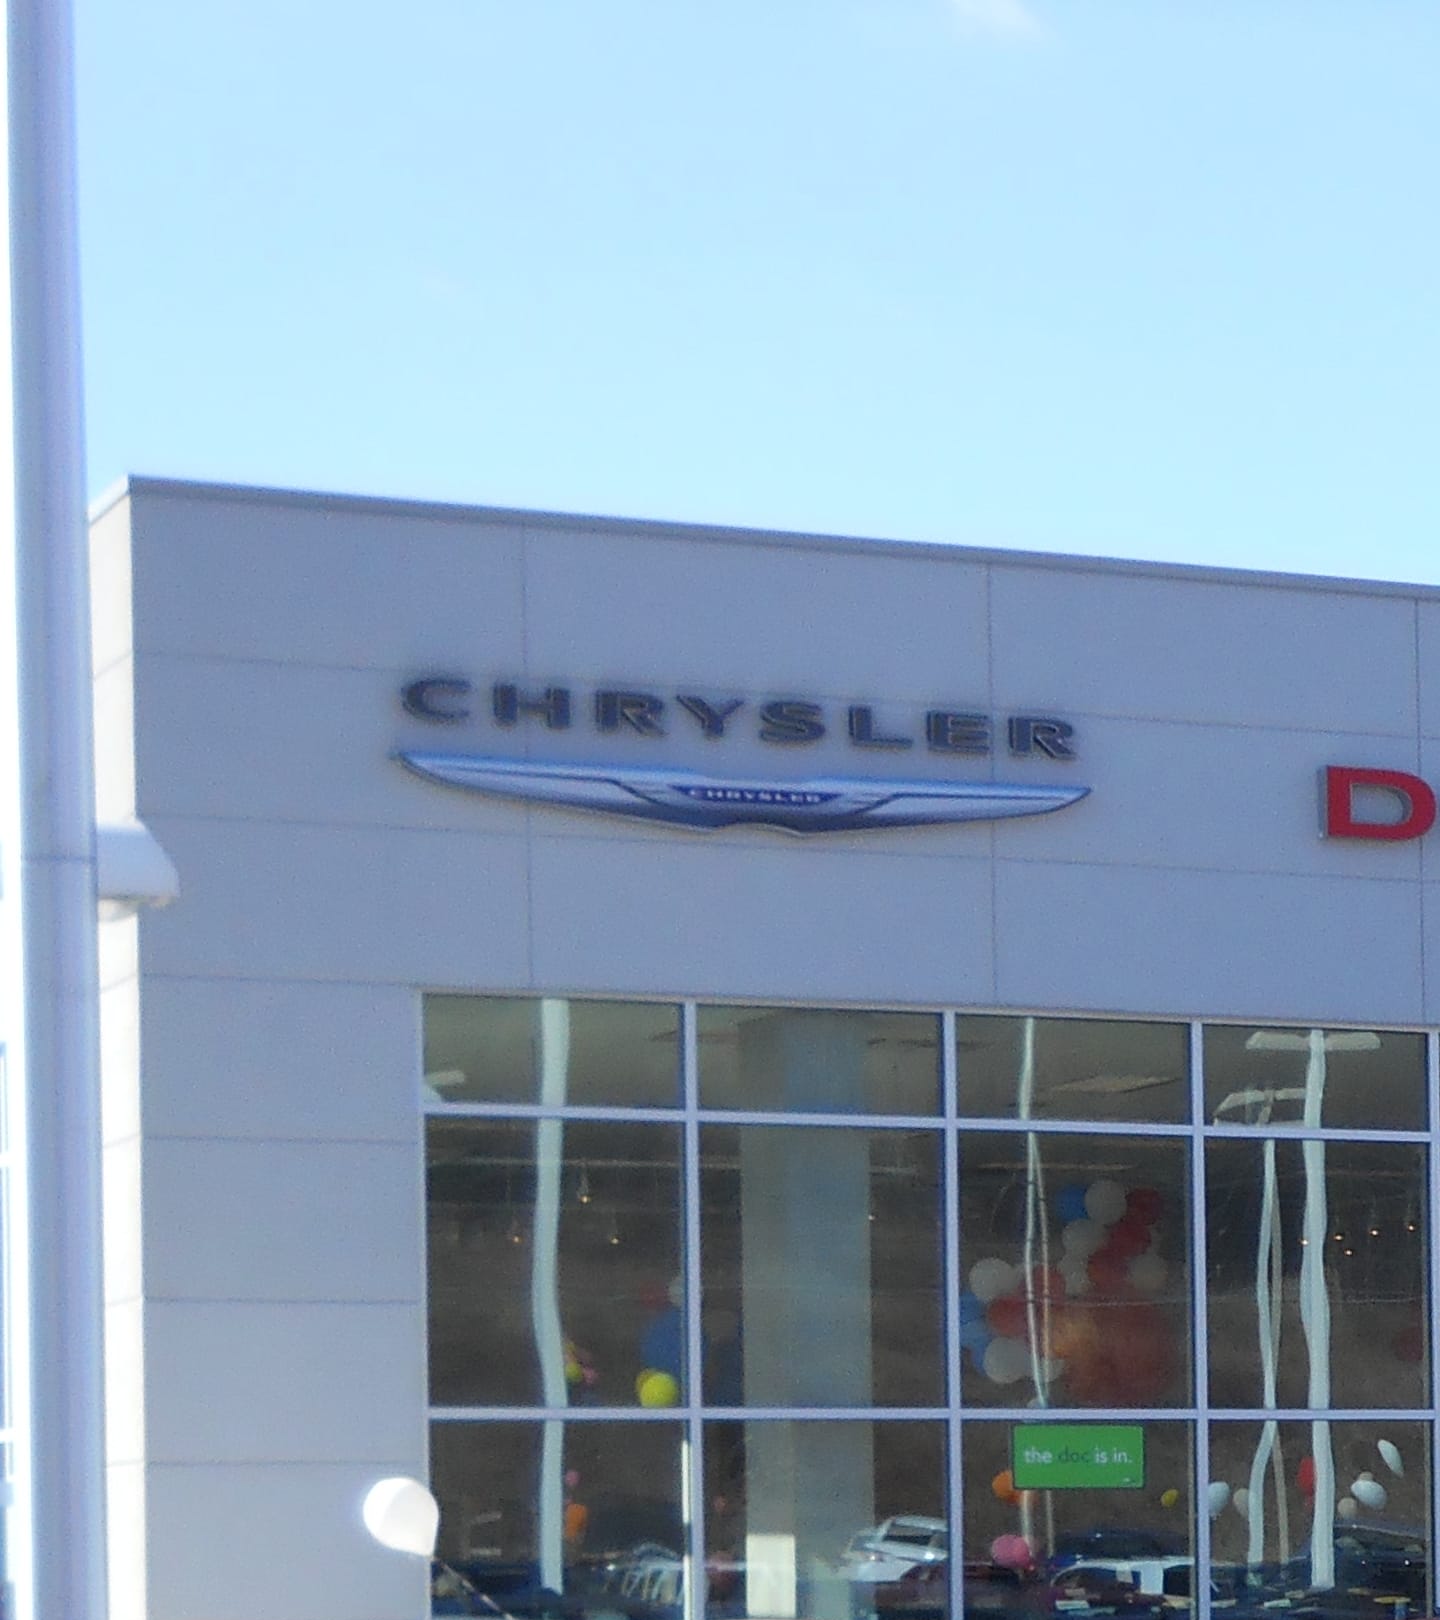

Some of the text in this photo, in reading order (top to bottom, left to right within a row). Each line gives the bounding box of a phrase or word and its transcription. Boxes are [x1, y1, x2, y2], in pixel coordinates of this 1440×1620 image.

[400, 676, 1079, 760] CHRYSLER
[1024, 1446, 1053, 1463] the
[1058, 1445, 1090, 1462] doc
[1094, 1445, 1108, 1463] is
